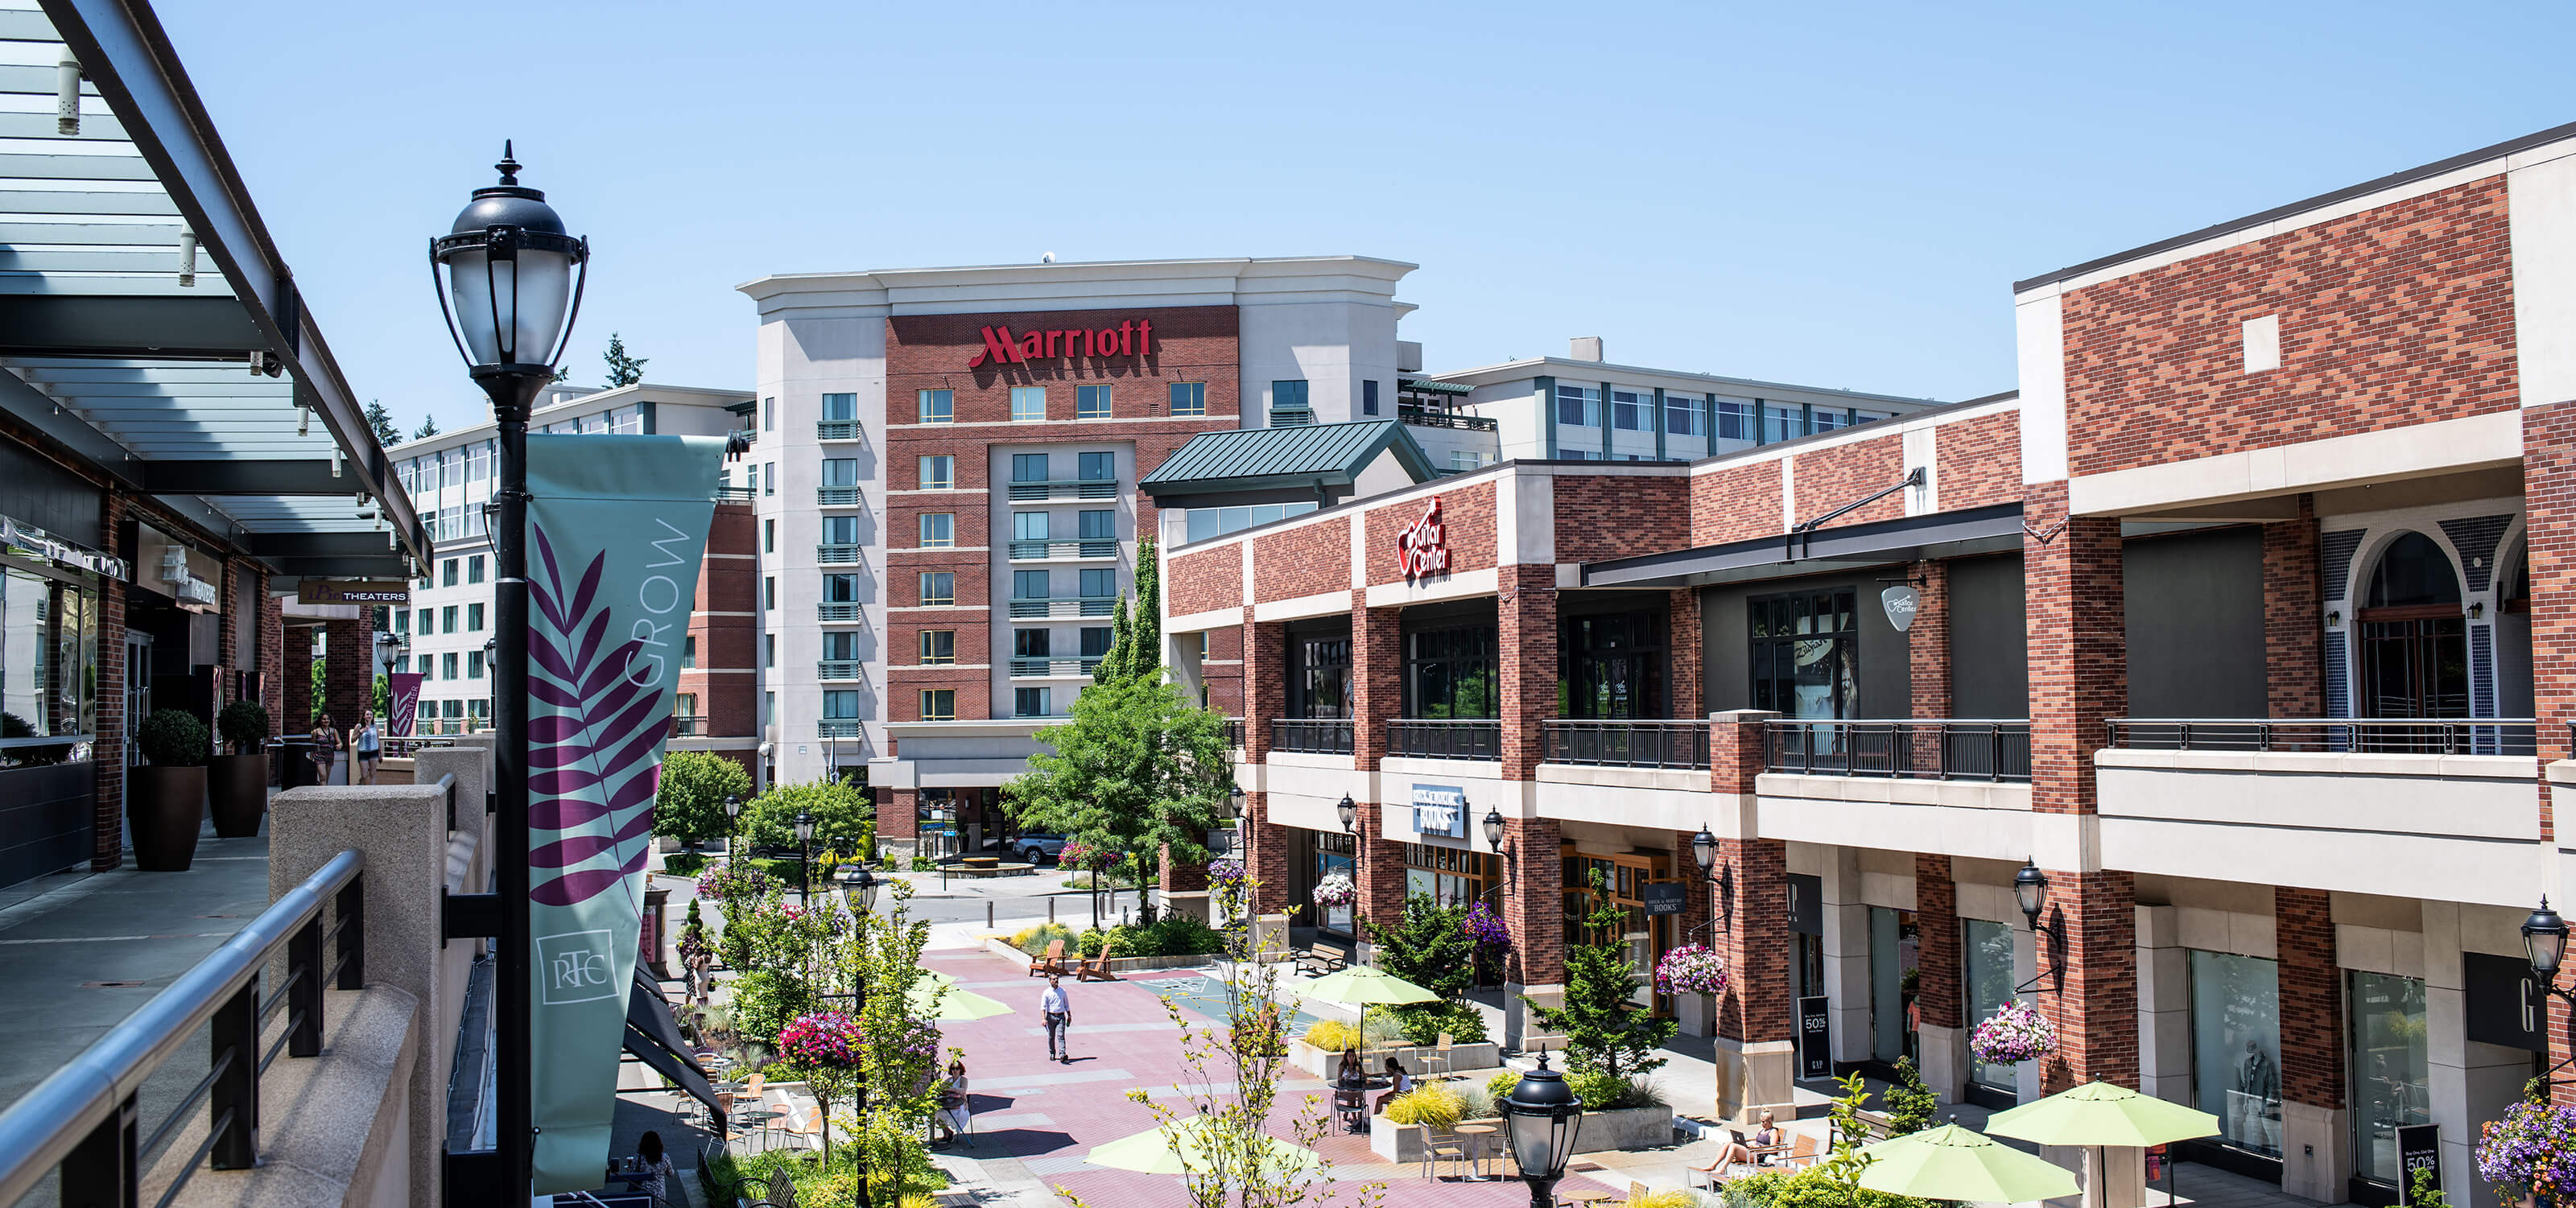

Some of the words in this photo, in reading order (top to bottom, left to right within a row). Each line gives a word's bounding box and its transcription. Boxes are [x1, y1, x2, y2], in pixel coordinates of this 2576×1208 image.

[968, 320, 1153, 368] Marriott
[1413, 545, 1447, 577] Center
[343, 592, 407, 601] THEATERS
[625, 518, 691, 687] GROW
[405, 685, 419, 721] GATHER
[1419, 806, 1452, 831] BOOKS
[1654, 903, 1677, 912] BOOKS
[1806, 1017, 1826, 1029] 50%
[1812, 1060, 1823, 1070] GAP
[2407, 1156, 2435, 1173] 50%
